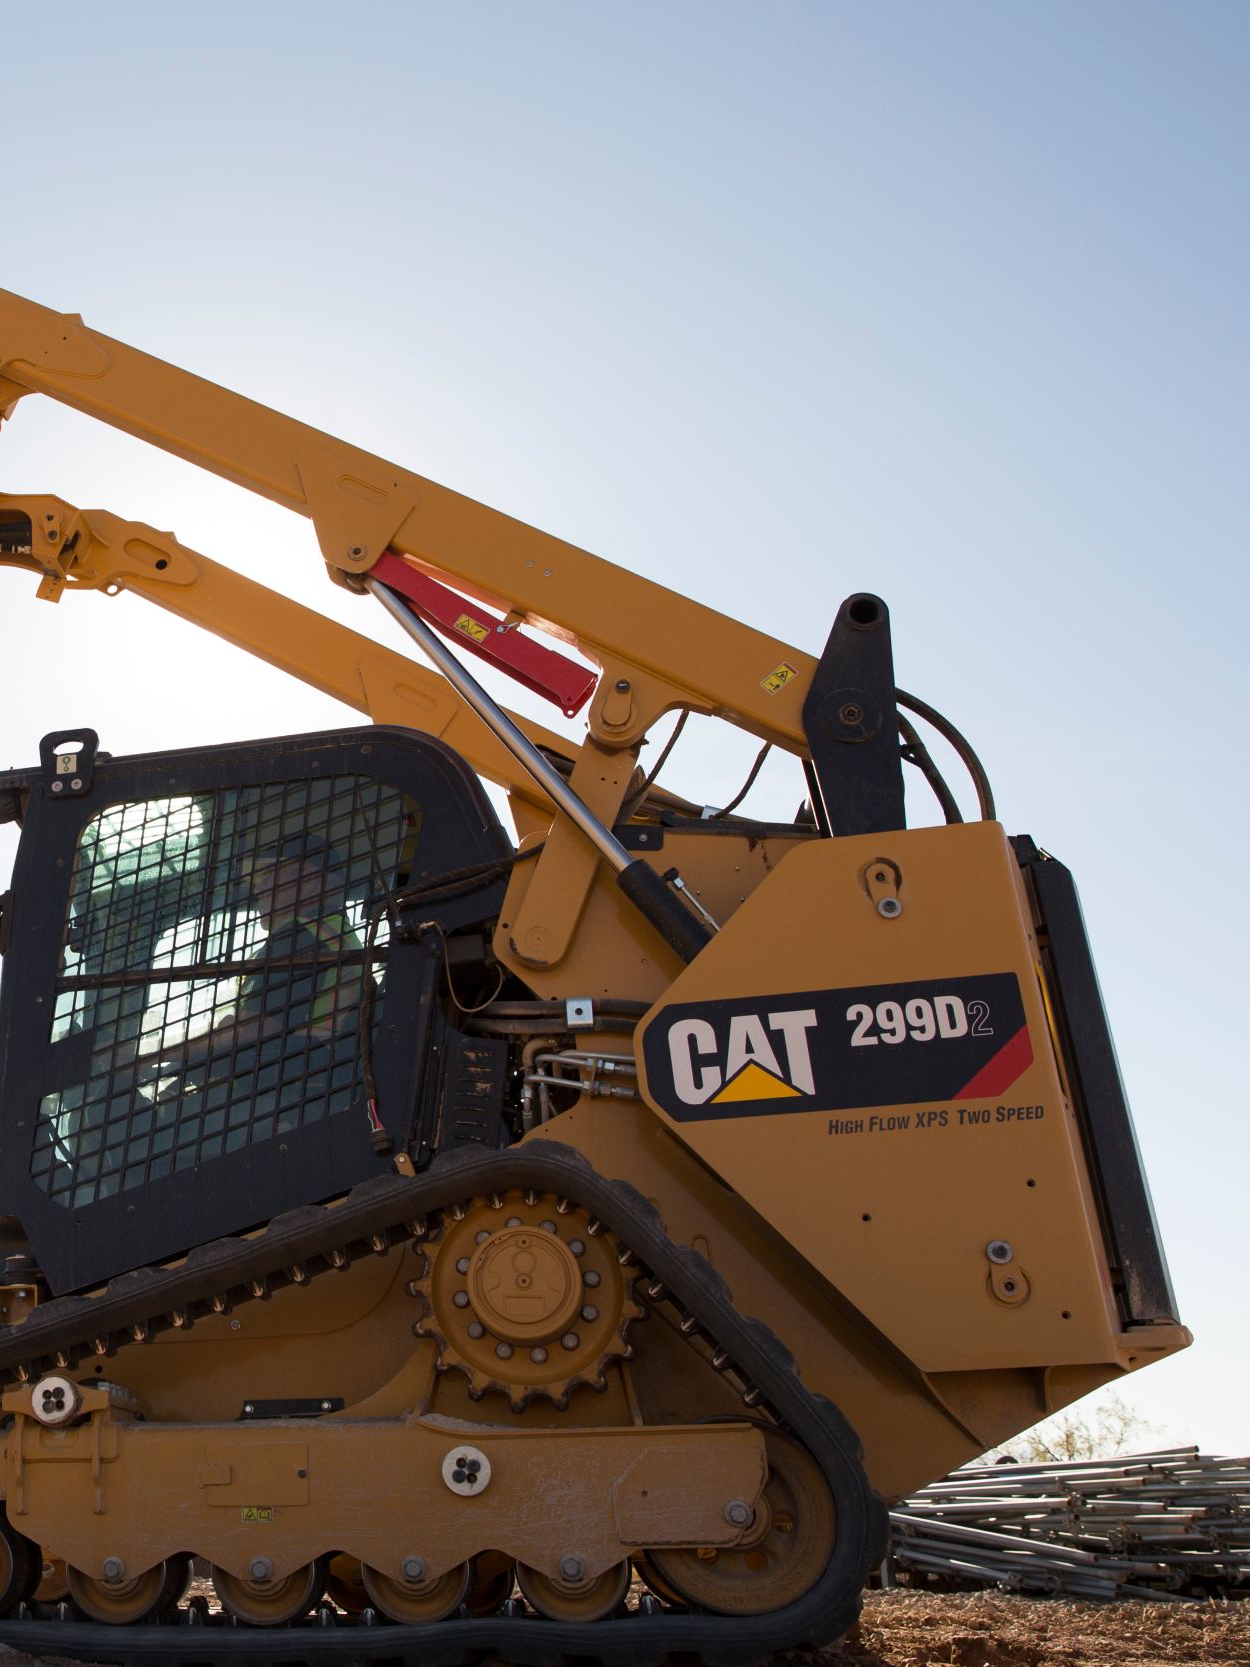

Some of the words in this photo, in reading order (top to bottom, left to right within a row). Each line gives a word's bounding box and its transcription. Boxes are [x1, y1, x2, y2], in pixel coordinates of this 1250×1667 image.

[667, 1009, 818, 1105] CAT
[845, 995, 994, 1047] 299D2
[828, 1119, 864, 1136] HIGH
[868, 1115, 910, 1132] FLOW
[915, 1110, 949, 1129] XPS
[957, 1108, 991, 1126] TWO
[995, 1105, 1045, 1123] SPEED
